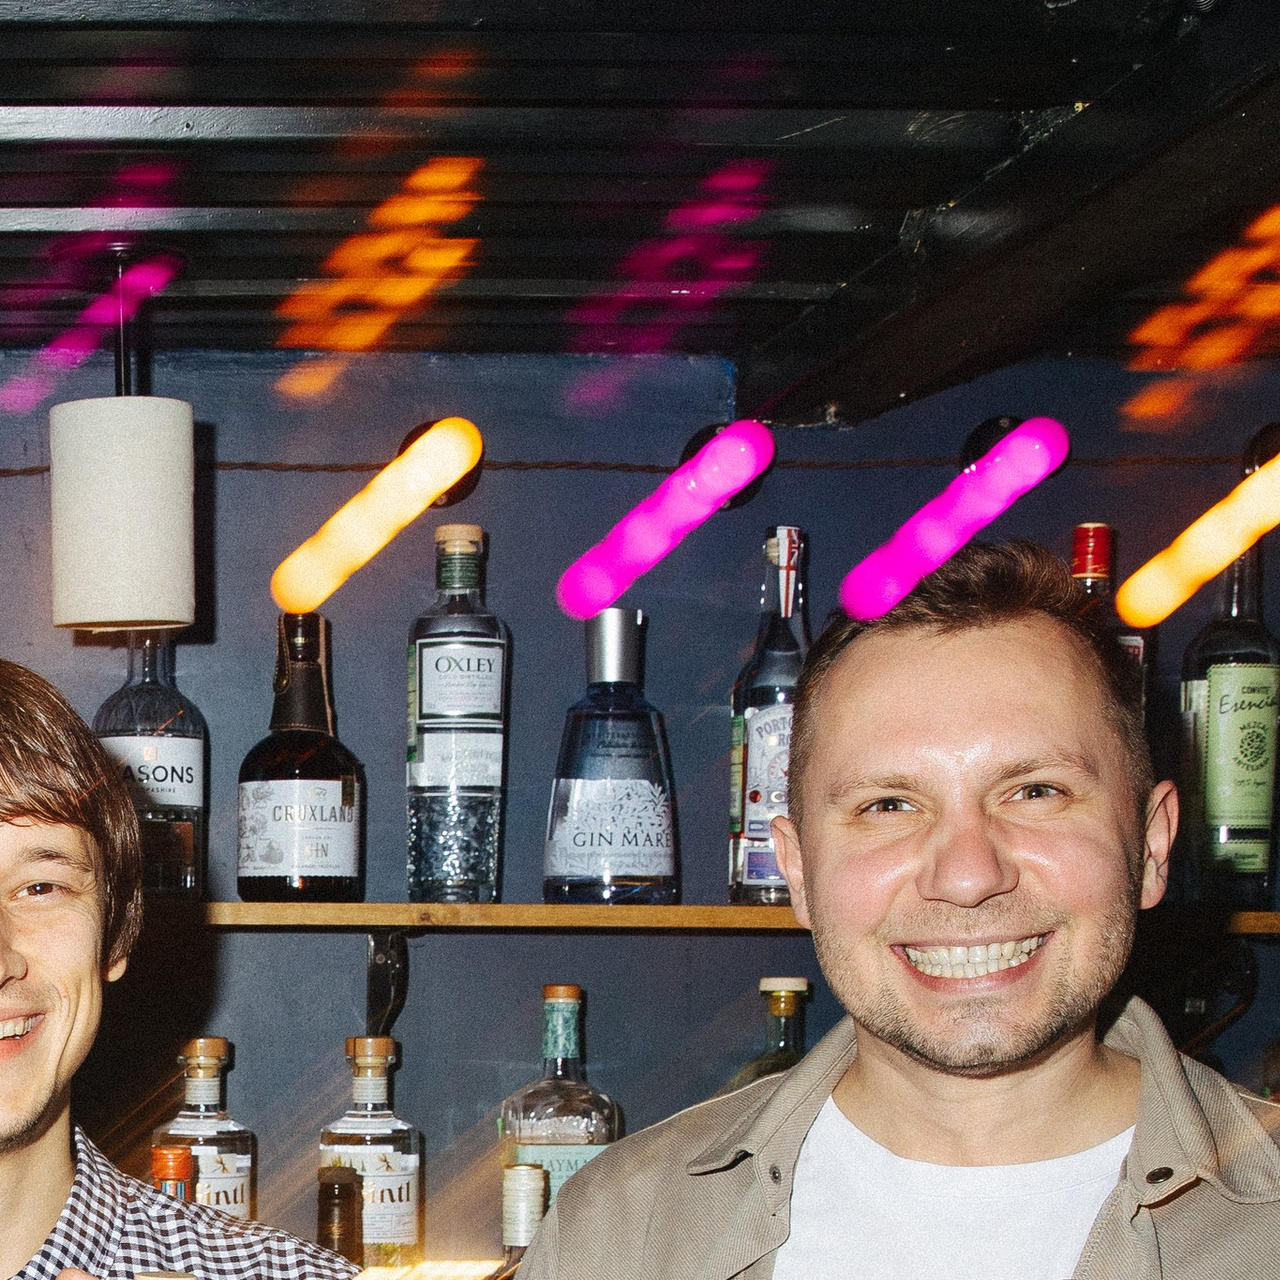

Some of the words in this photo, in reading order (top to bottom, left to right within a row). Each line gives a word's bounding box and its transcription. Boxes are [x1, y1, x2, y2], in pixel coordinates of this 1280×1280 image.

[435, 656, 496, 673] OXLEY
[272, 805, 355, 823] CRUXLAND
[572, 831, 613, 848] GIN
[621, 832, 673, 849] MARE
[361, 1181, 411, 1204] intl
